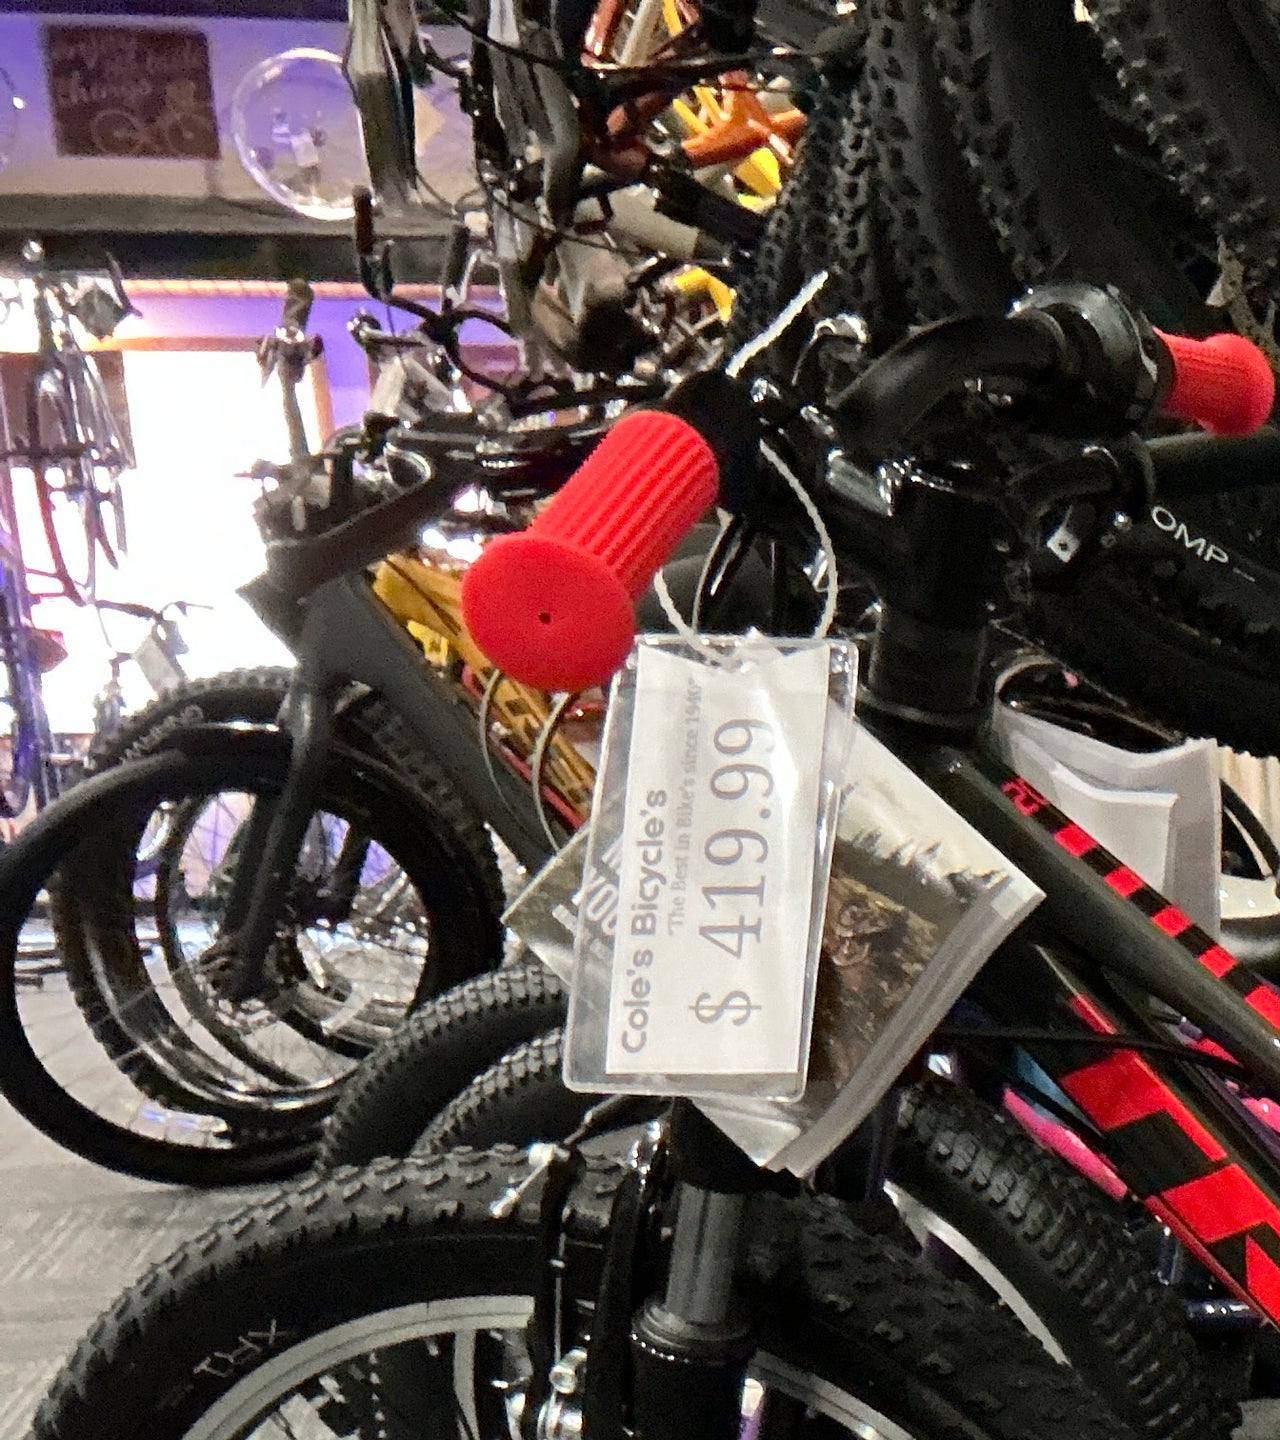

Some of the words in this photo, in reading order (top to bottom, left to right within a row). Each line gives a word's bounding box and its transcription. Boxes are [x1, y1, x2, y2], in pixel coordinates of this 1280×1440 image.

[683, 737, 700, 775] since
[677, 779, 695, 829] Bike's
[631, 789, 667, 936] Bicycle's
[699, 718, 775, 960] 419.99
[673, 854, 688, 891] Best
[621, 949, 653, 1053] Cole's
[688, 990, 762, 1027] $
[192, 1318, 298, 1379] XR1
